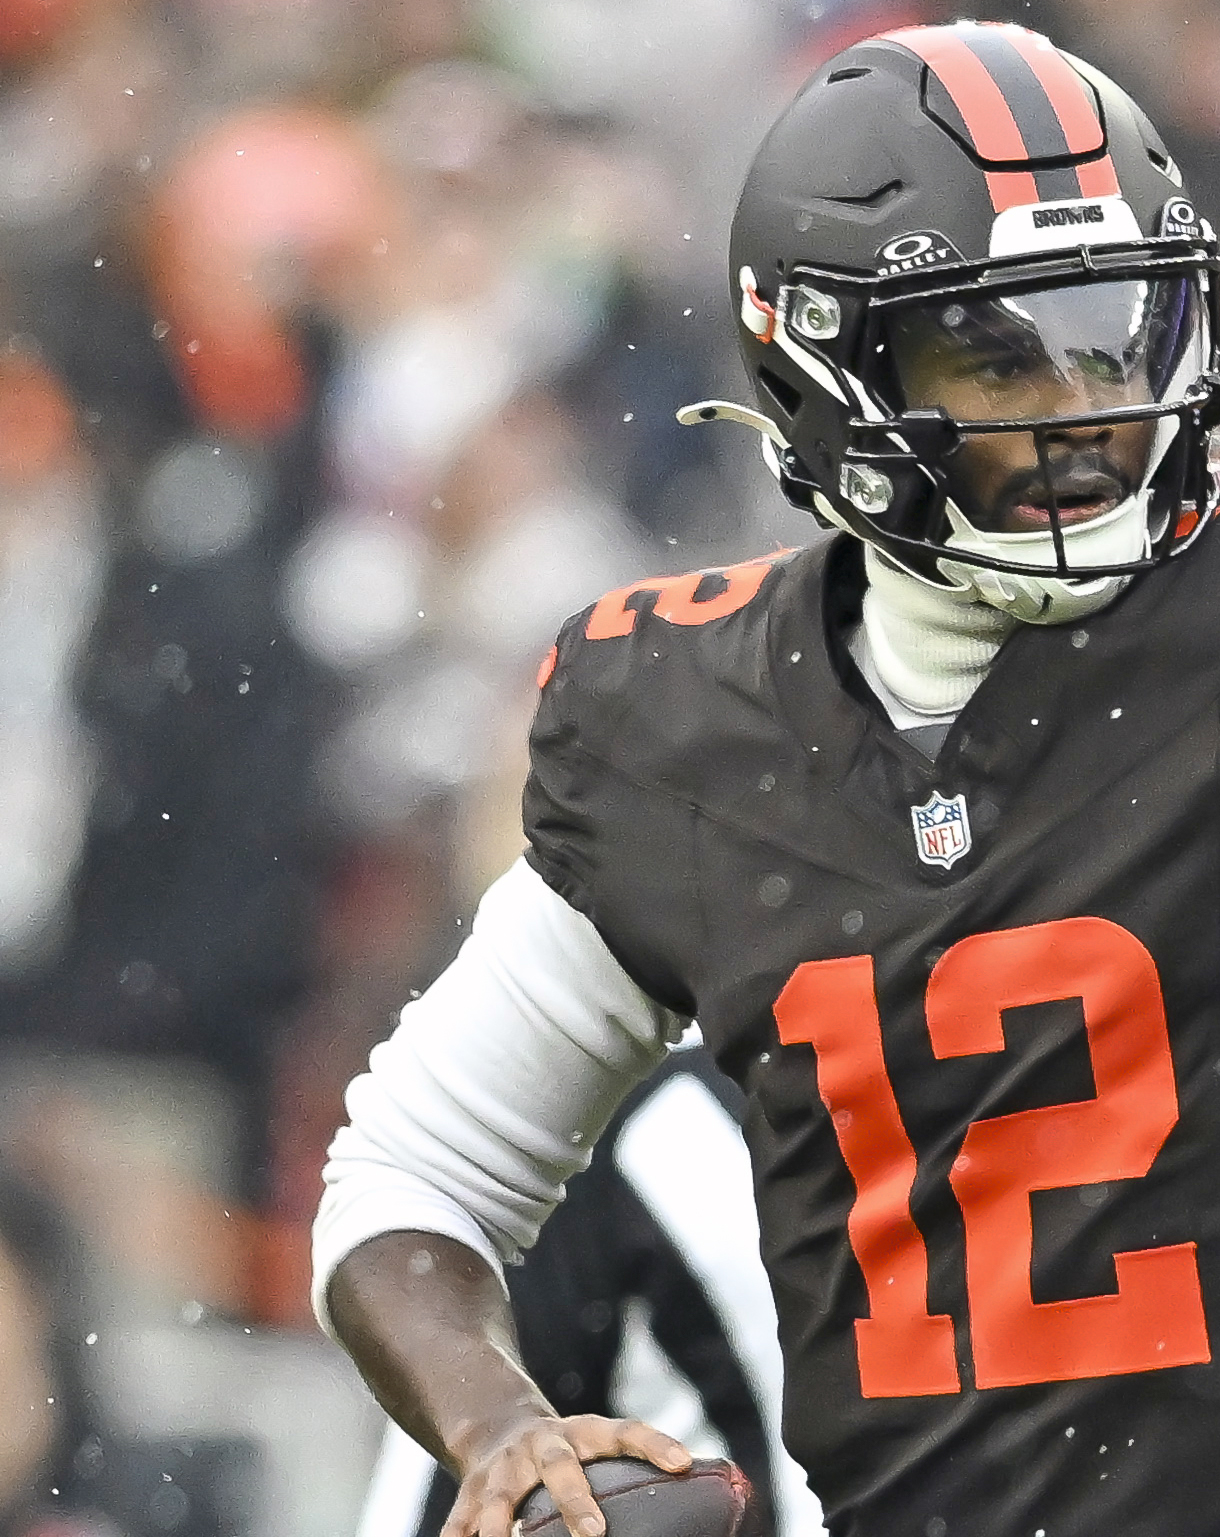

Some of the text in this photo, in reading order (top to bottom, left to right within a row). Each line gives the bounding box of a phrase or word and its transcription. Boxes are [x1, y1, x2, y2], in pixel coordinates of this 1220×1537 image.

[1032, 205, 1104, 229] BROWNS
[877, 247, 951, 277] OAKLEY
[924, 825, 962, 856] NFL
[773, 915, 1212, 1399] 12
